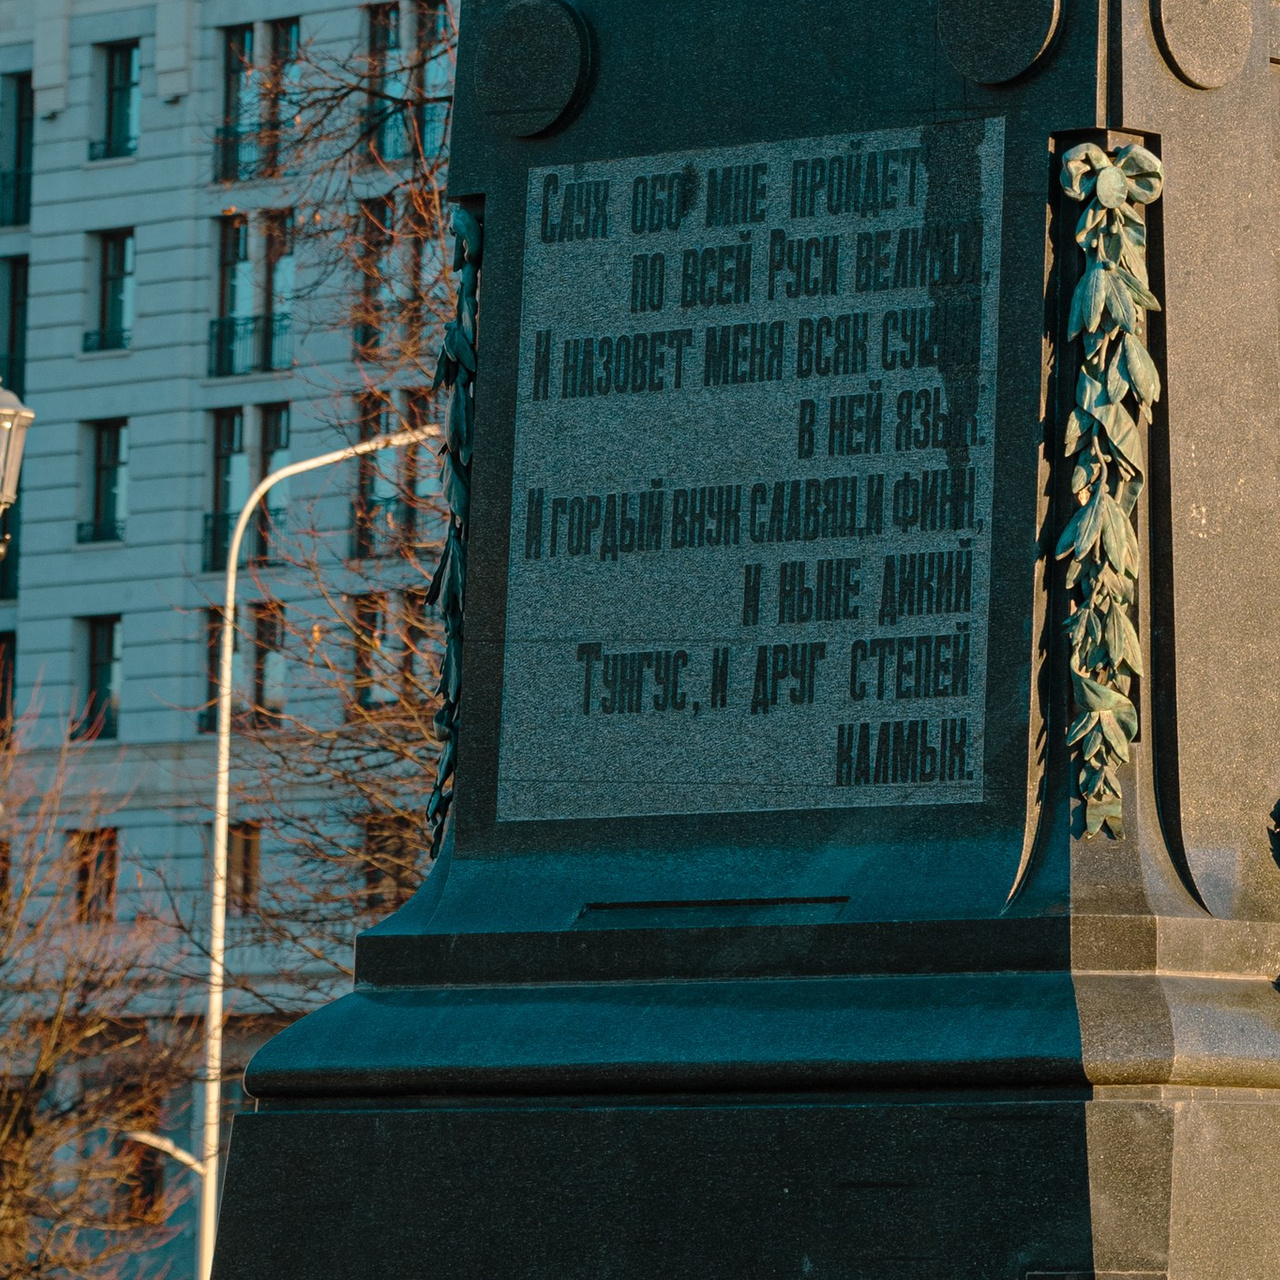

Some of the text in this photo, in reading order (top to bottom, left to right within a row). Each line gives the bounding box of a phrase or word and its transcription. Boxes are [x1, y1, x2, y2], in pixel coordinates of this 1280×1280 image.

[631, 172, 683, 234] ОБО
[706, 163, 767, 226] МНЕ
[791, 141, 921, 219] ПРОЙДЕТ
[631, 253, 664, 313] ПО
[681, 230, 752, 307] ВСЕЙ
[533, 330, 551, 401] И
[562, 328, 692, 398] НАЗОВЕТ
[704, 320, 785, 386] МЕНЯ
[800, 312, 868, 379] ВСЯК
[799, 399, 815, 459] В
[828, 379, 882, 457] НЕЙ
[525, 488, 543, 559] И
[550, 479, 664, 561] ГОРДЫЙ
[671, 484, 741, 549] ВНУК
[742, 538, 973, 626] И НЫНЕ ДИКИЙ
[710, 647, 729, 708] И
[751, 642, 827, 715] ДРУГ
[849, 623, 971, 702] СТЕПЕЙ
